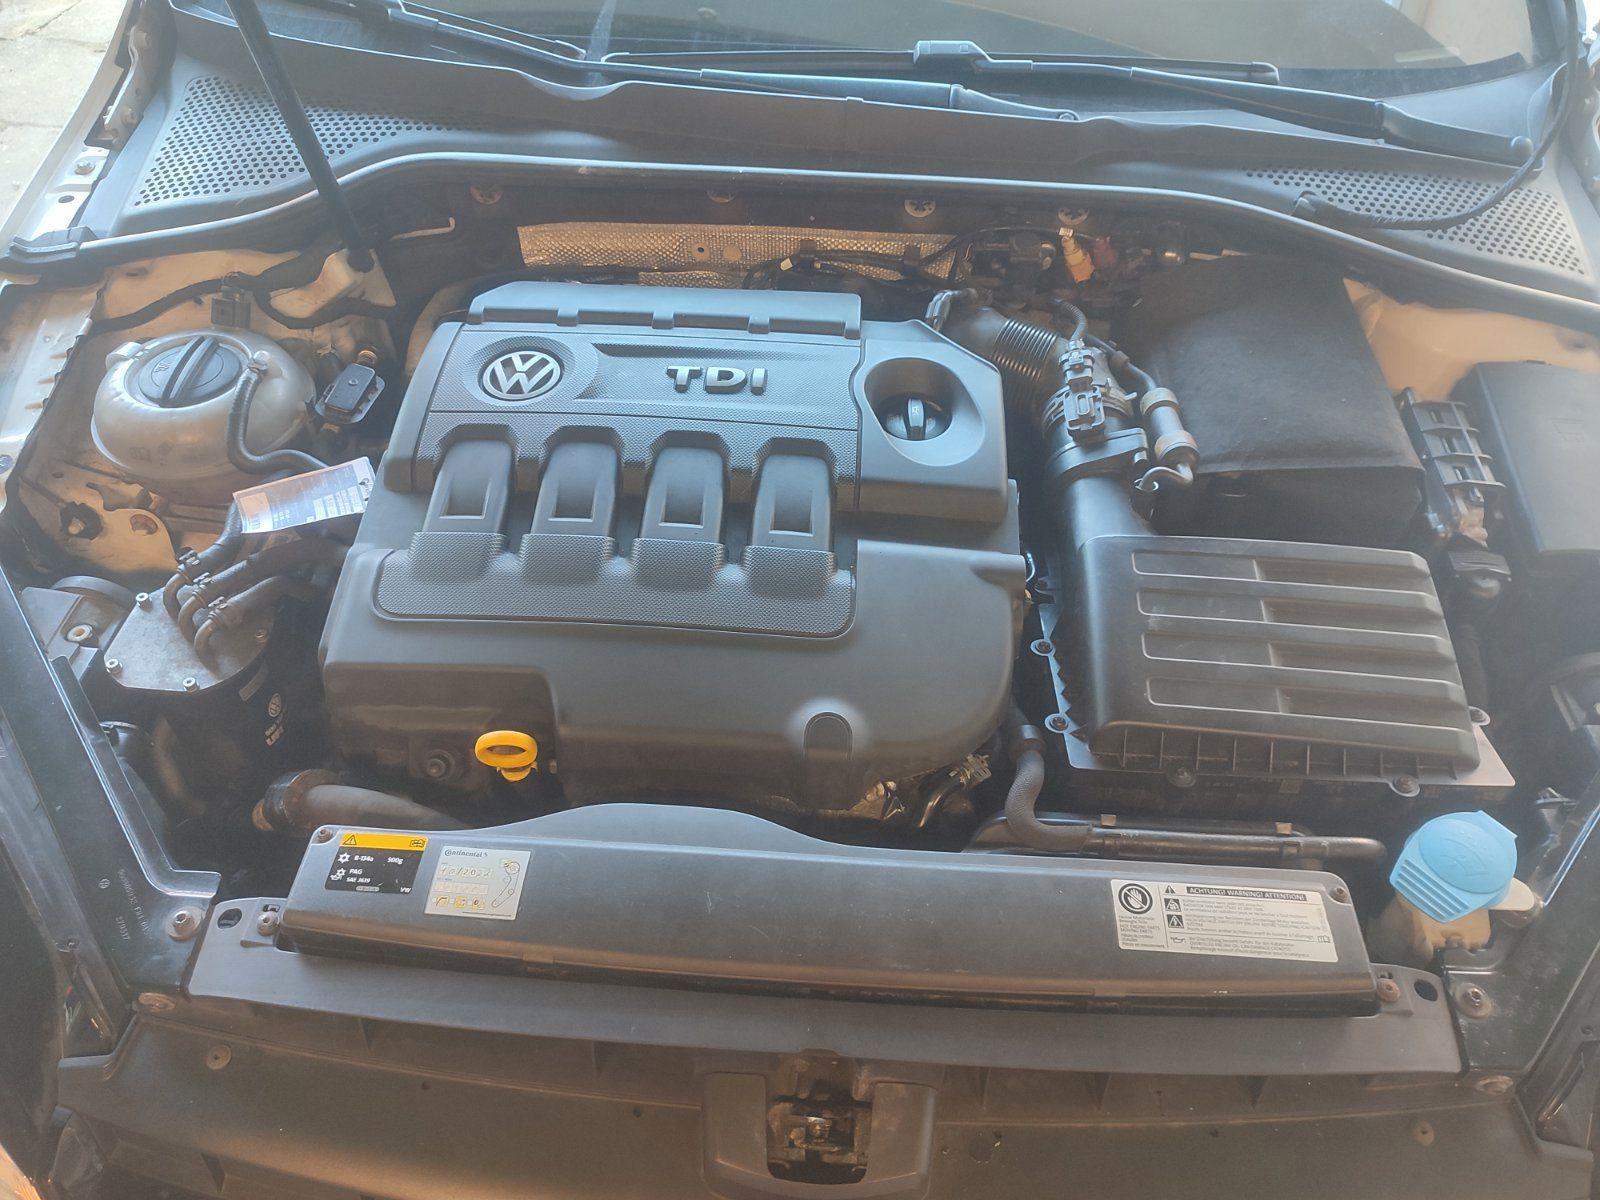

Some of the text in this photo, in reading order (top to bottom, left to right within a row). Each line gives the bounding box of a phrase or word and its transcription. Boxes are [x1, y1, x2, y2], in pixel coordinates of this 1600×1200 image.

[666, 364, 768, 395] TDI
[444, 848, 483, 858] Continental
[387, 856, 404, 865] 500g
[1189, 886, 1305, 901] ACHTUNG! WARNING! ATTENTION!
